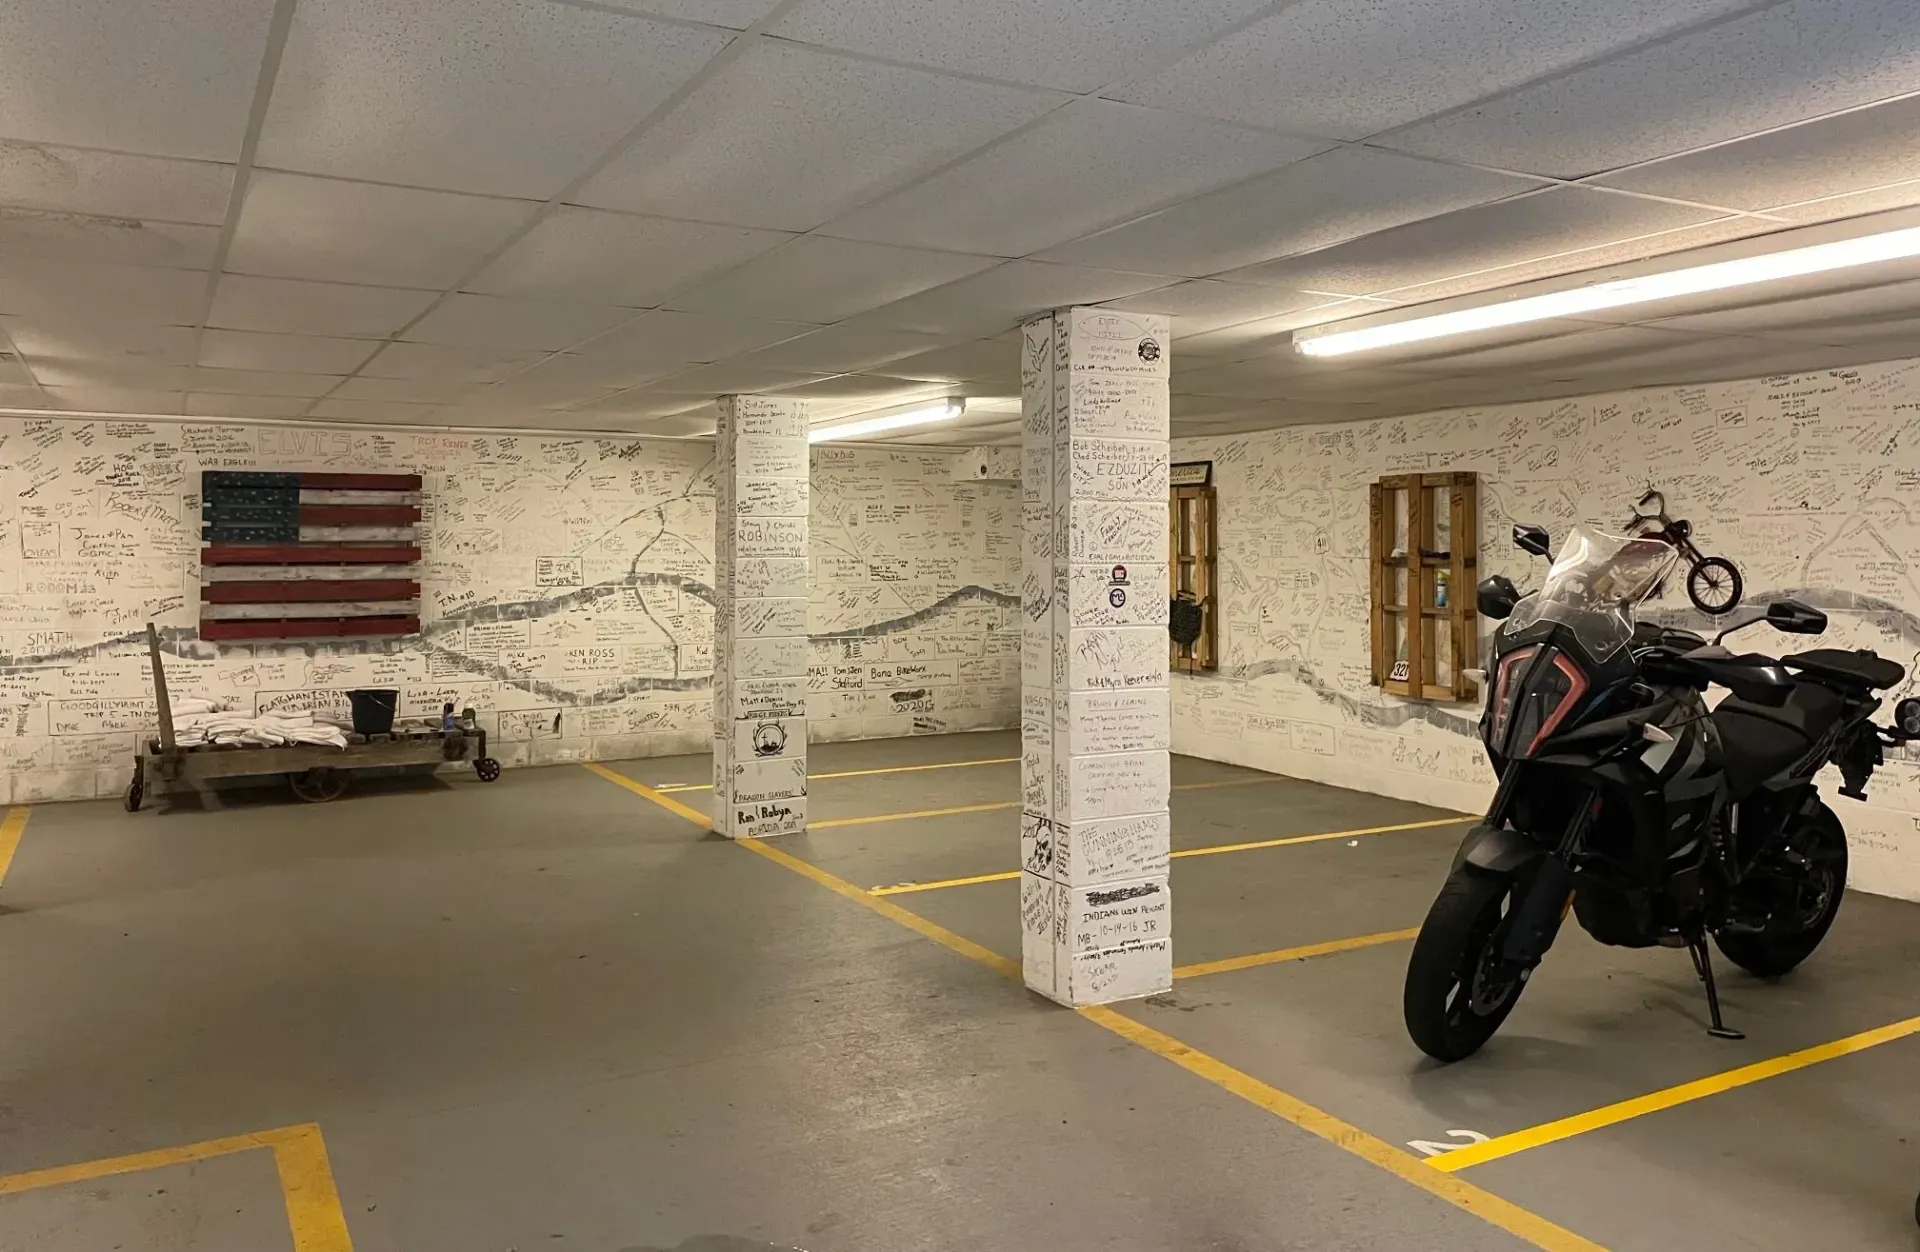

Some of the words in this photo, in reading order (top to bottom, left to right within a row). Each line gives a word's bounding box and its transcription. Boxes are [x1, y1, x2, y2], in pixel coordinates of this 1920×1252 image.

[257, 428, 352, 456] ELVIS
[412, 435, 436, 446] TROY
[1072, 440, 1089, 451] Bob
[1096, 462, 1150, 476] EZDUZIT
[1107, 479, 1129, 491] SON
[738, 530, 803, 543] ROBINSON
[588, 648, 616, 658] ROSS
[894, 699, 924, 713] 2020
[761, 804, 792, 822] Robyn
[1142, 919, 1157, 934] JR
